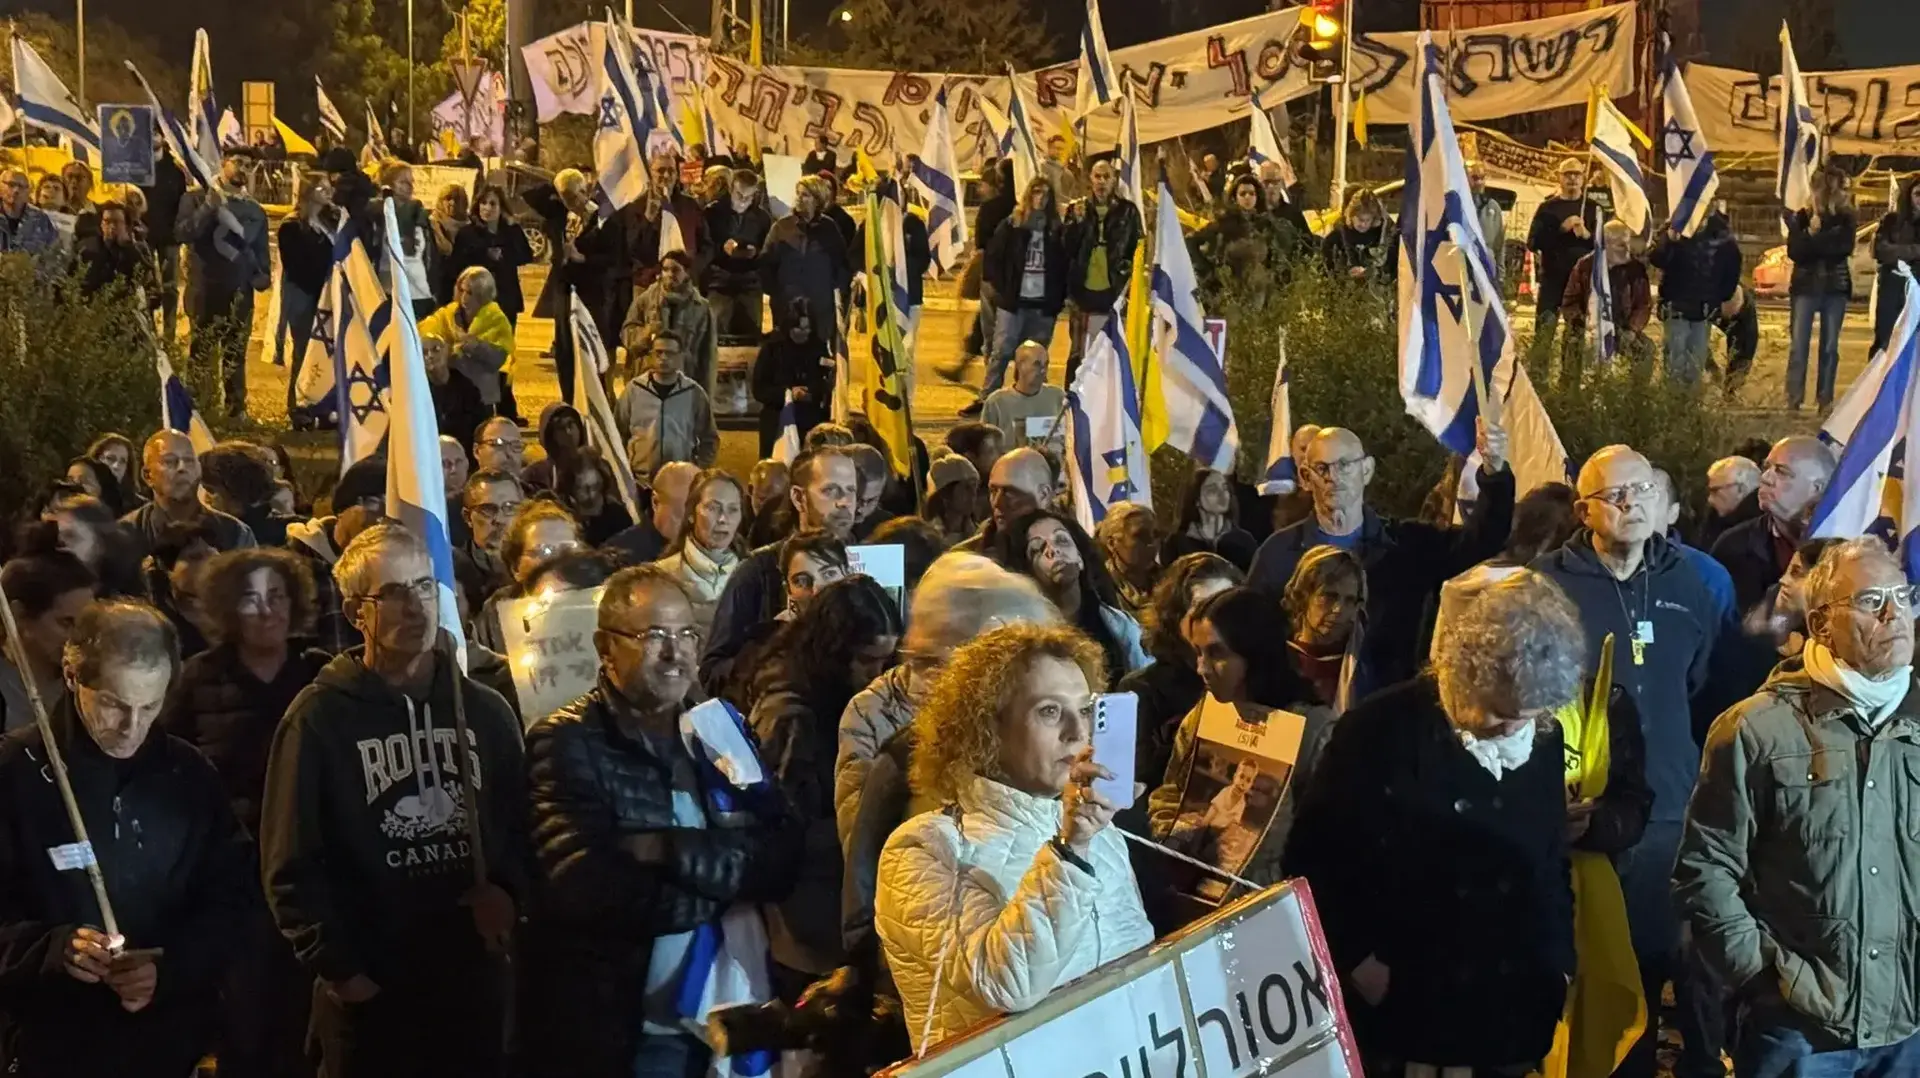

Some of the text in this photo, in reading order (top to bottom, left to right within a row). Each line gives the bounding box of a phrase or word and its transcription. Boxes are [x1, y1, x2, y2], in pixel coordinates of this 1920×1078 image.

[356, 727, 482, 805] ROOTS
[385, 838, 472, 869] CANAD
[1197, 953, 1330, 1070] אסור
